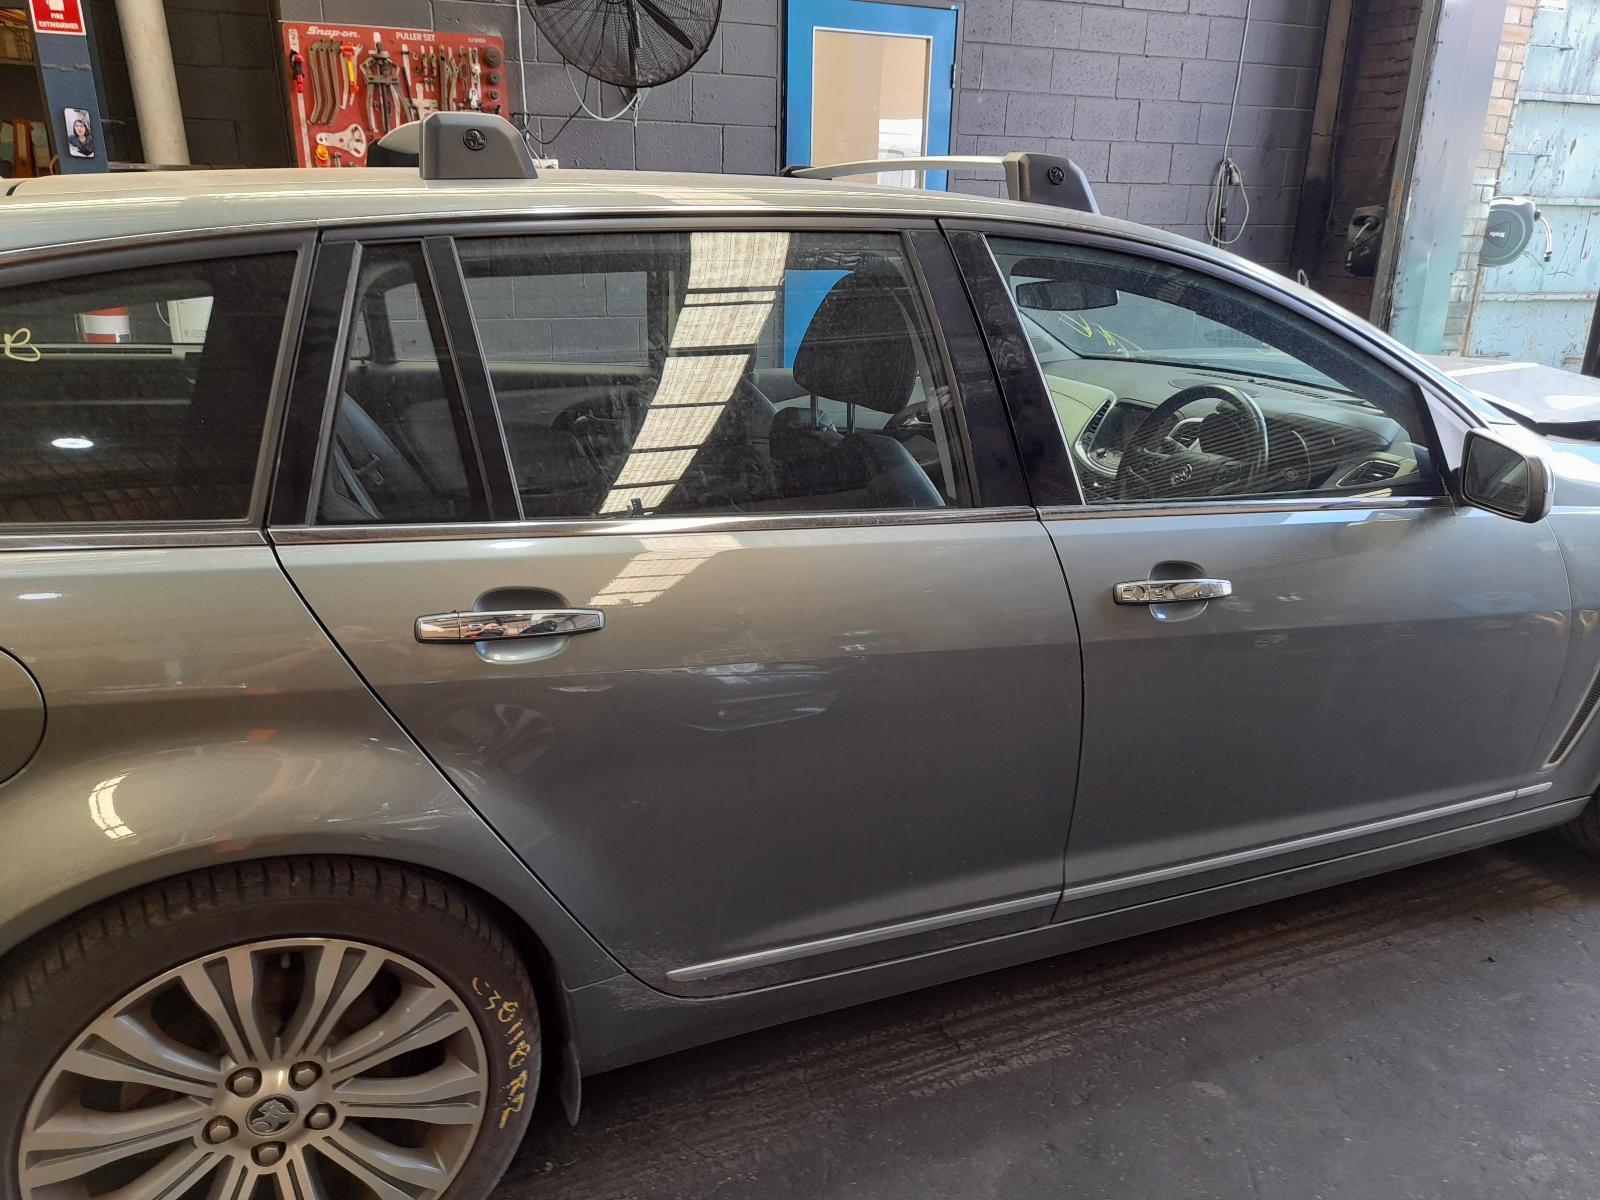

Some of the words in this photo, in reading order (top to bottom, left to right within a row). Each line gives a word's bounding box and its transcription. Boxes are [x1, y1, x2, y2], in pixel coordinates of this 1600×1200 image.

[306, 26, 360, 38] Snap-on
[395, 31, 423, 42] PULLER
[423, 33, 435, 43] SET
